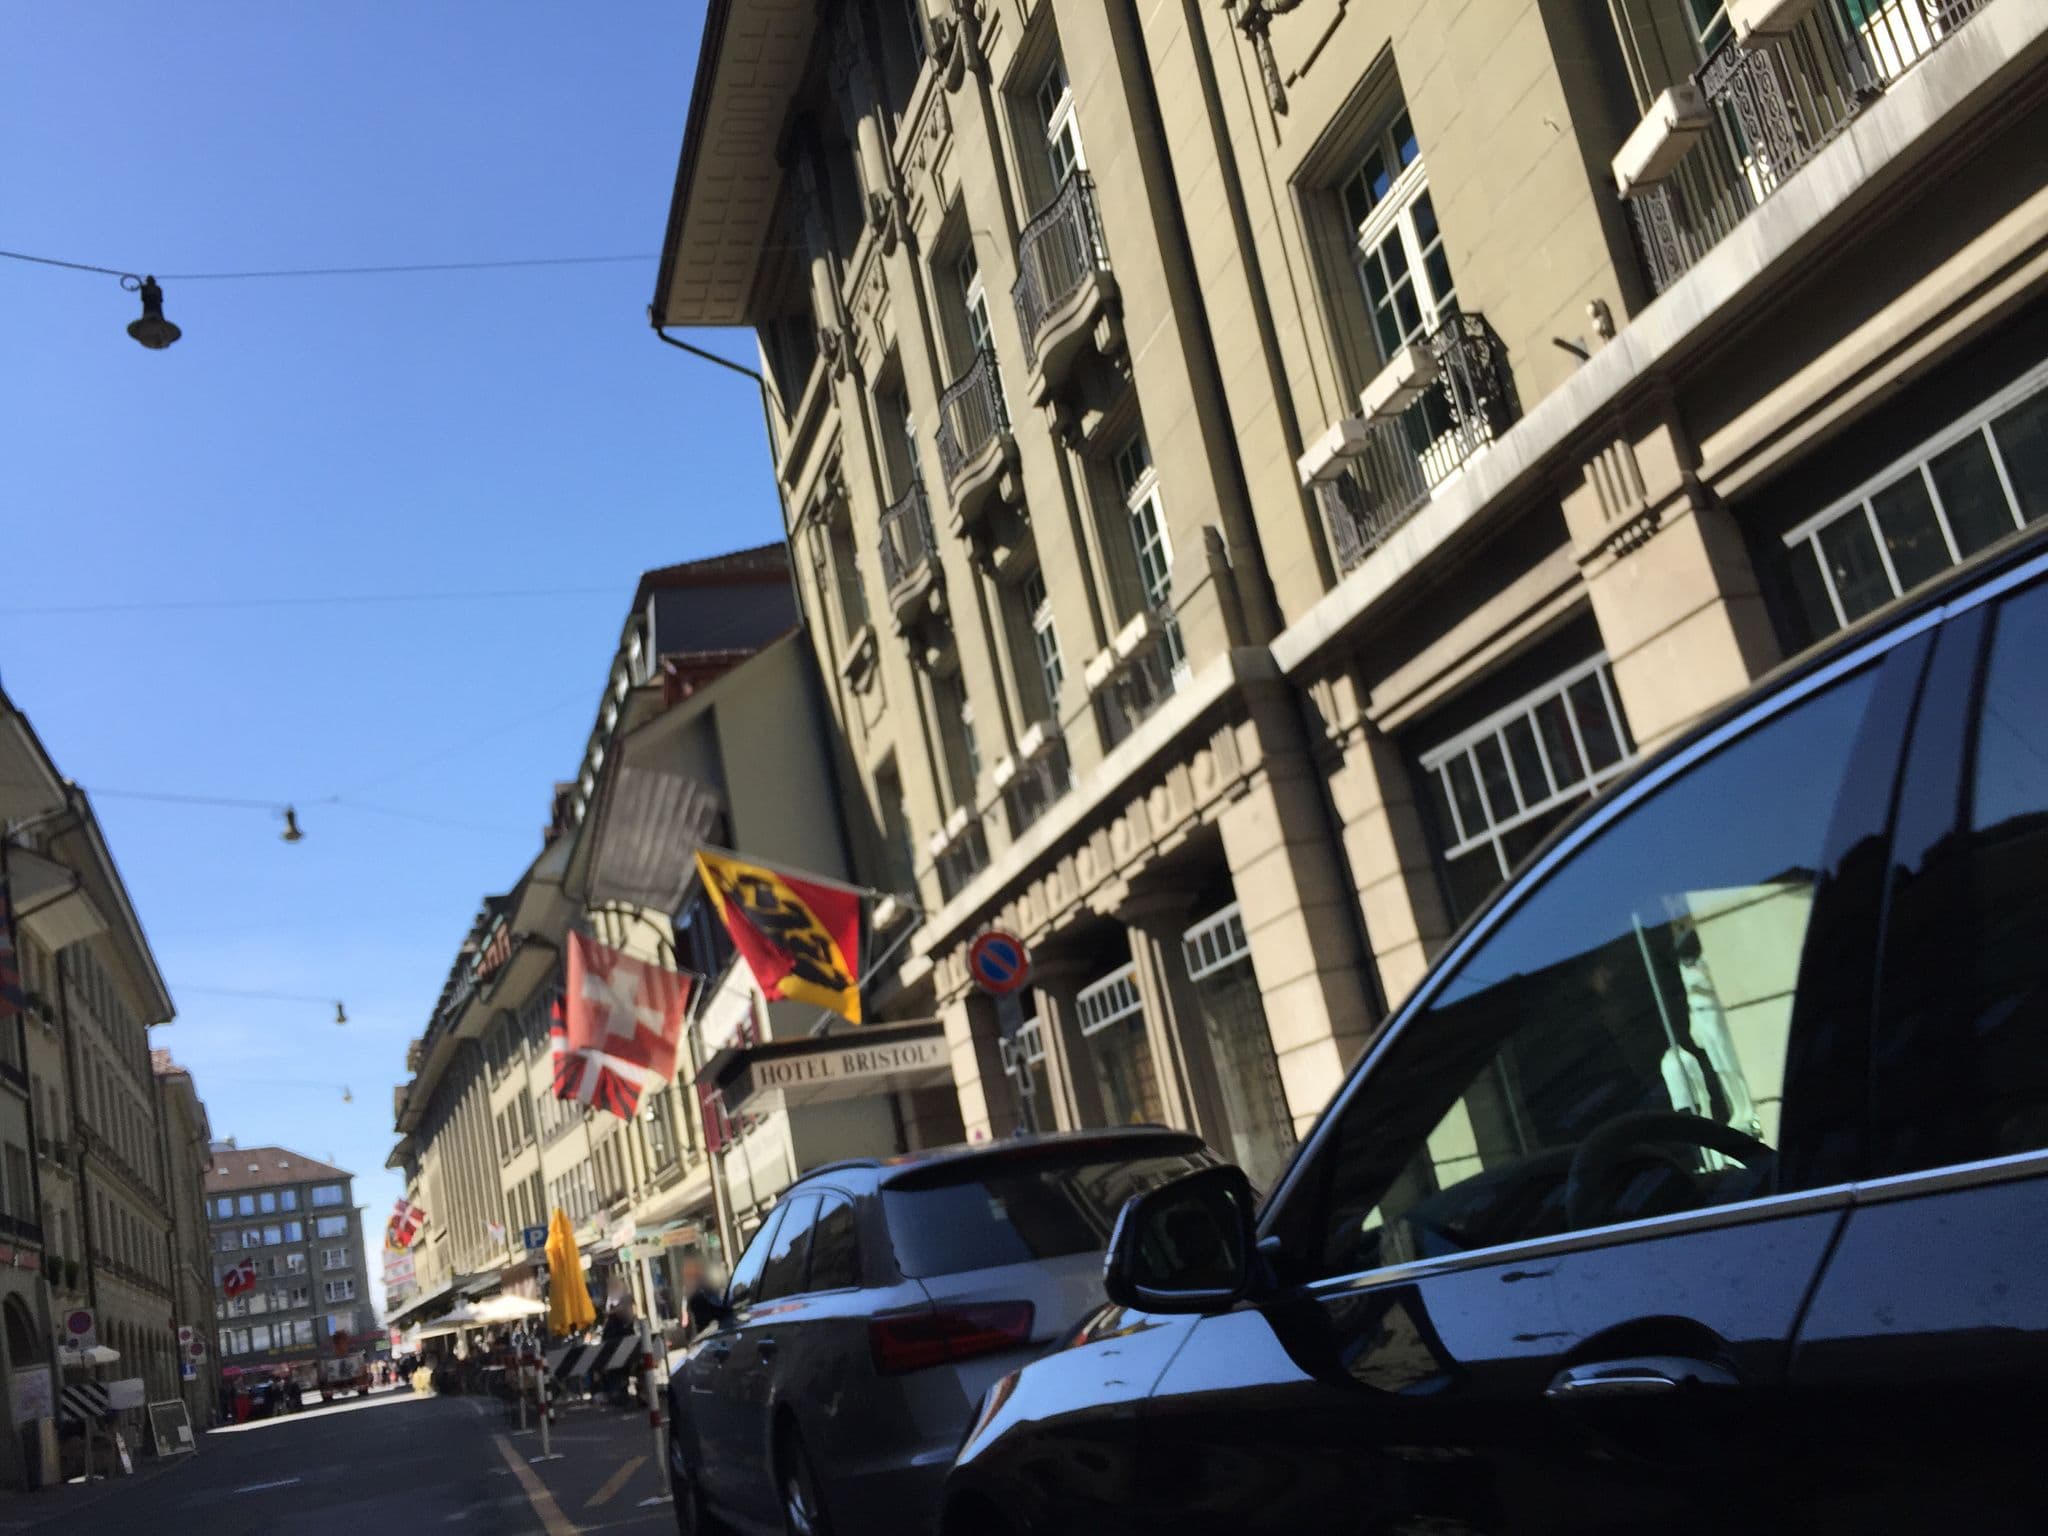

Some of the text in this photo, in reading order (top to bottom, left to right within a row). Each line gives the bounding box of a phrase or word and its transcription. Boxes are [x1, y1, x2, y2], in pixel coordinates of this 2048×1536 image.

[759, 1044, 931, 1086] HOTEL BRISTOL
[529, 1230, 544, 1247] P
